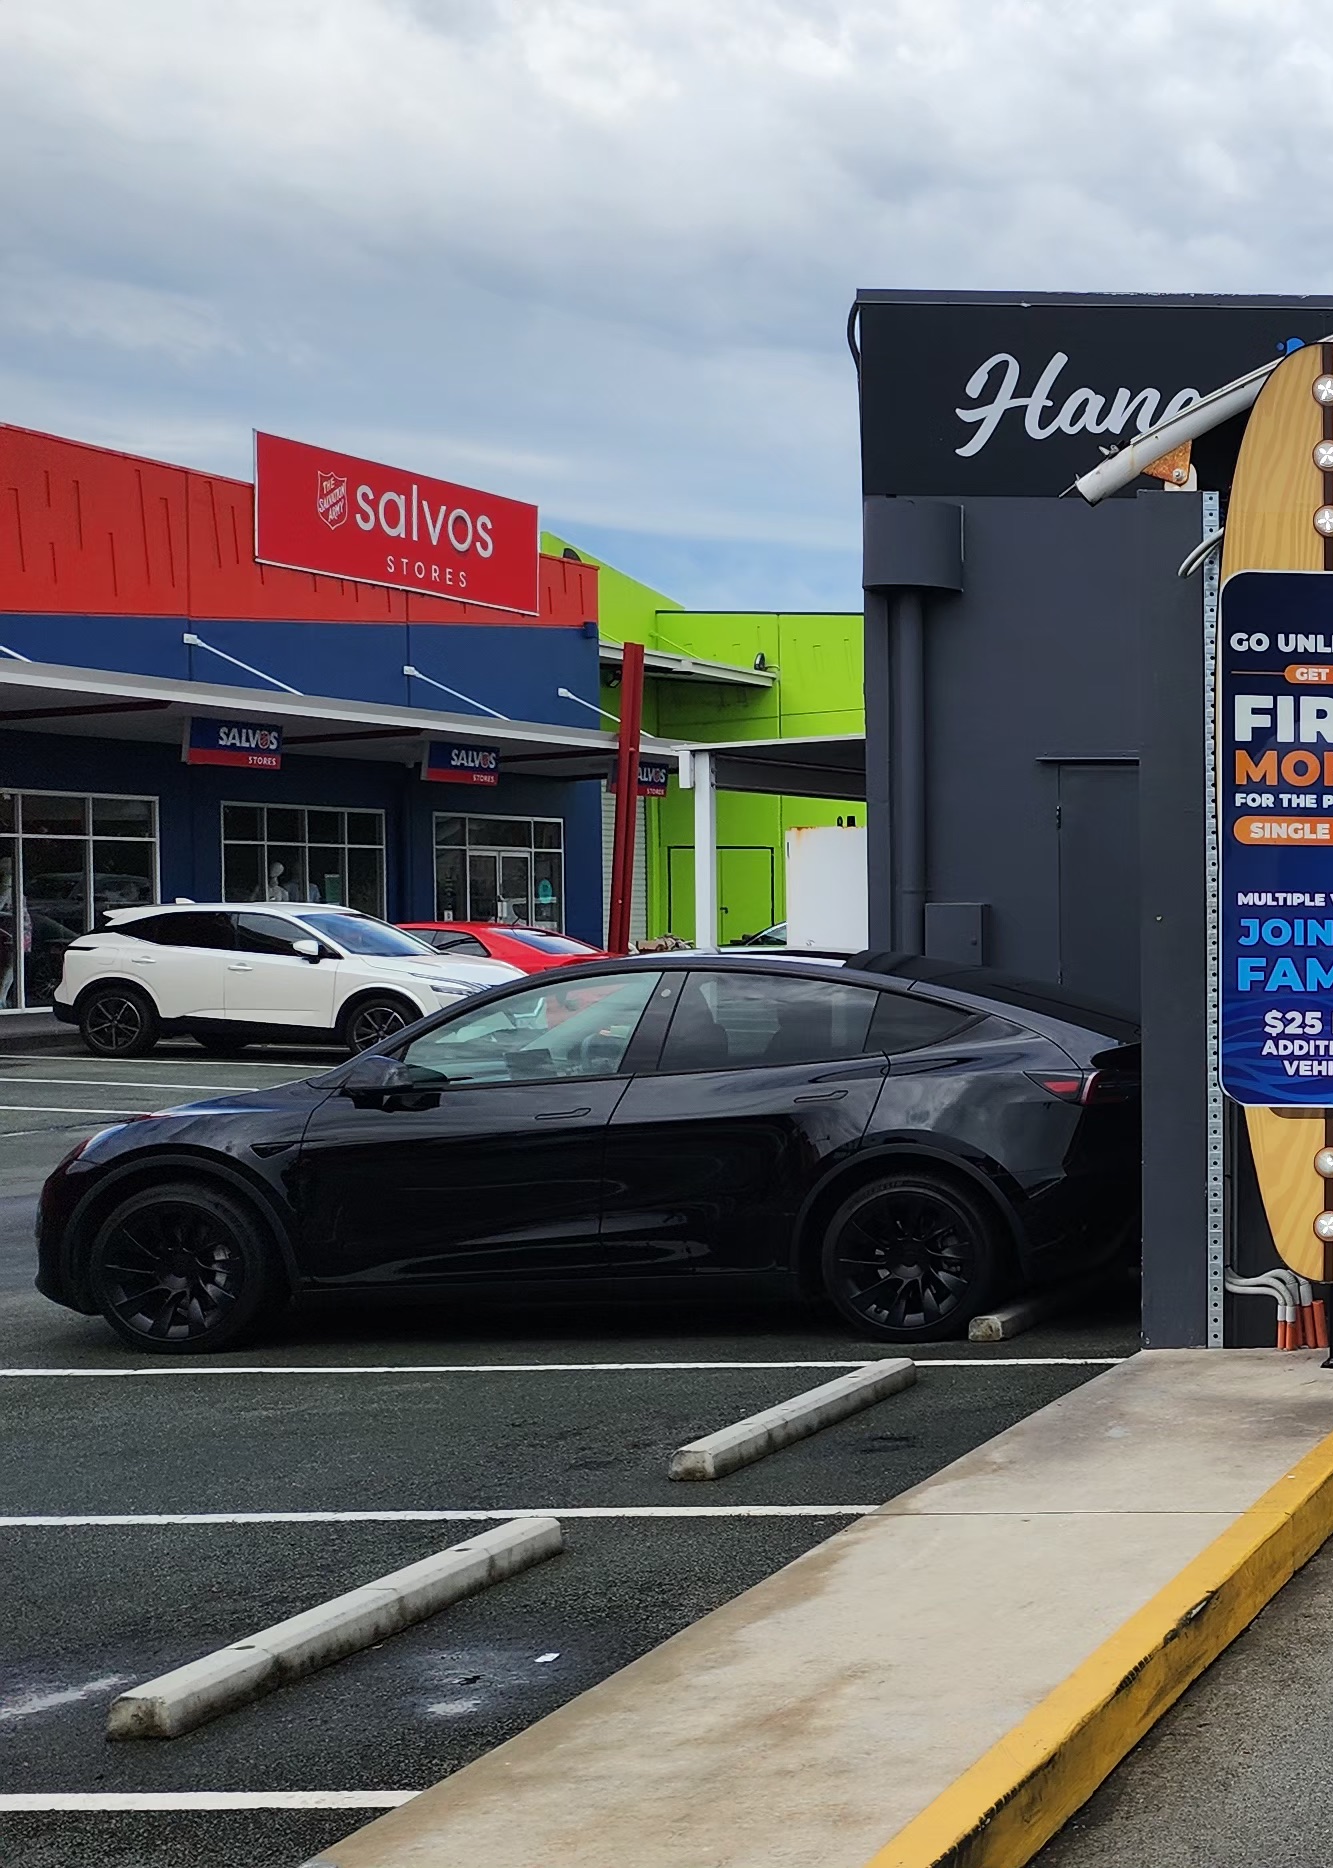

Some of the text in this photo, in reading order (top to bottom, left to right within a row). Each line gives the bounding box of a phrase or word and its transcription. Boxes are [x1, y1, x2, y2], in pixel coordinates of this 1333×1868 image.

[322, 477, 335, 494] THE
[318, 483, 346, 513] SALVATION
[327, 498, 344, 522] ARMY
[355, 484, 493, 558] salvos
[386, 555, 467, 588] STORES
[1230, 632, 1270, 652] GO
[1295, 667, 1329, 682] GET
[218, 726, 279, 750] SALVOS
[248, 755, 277, 766] STORES
[450, 749, 497, 769] SALVOS
[472, 774, 495, 783] STORES
[637, 767, 666, 783] ALVOS
[1234, 792, 1275, 808] FOR
[1278, 793, 1318, 808] THE
[1250, 822, 1331, 840] SINGLE
[1237, 892, 1326, 907] MULTIPLE
[1263, 1009, 1324, 1037] $25
